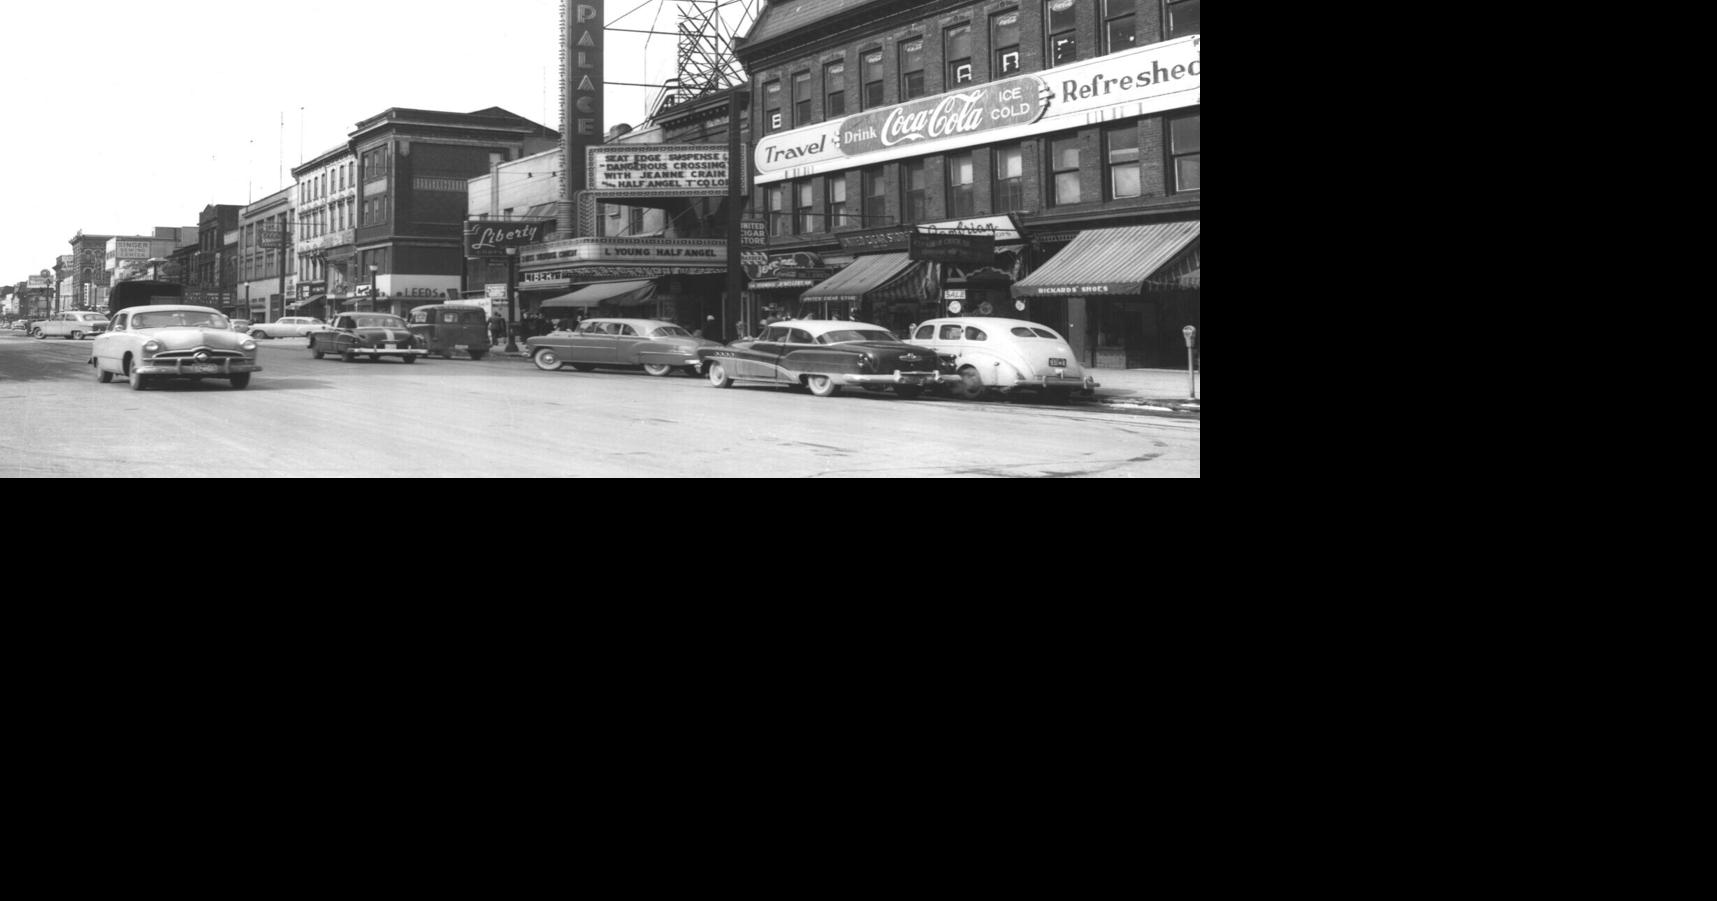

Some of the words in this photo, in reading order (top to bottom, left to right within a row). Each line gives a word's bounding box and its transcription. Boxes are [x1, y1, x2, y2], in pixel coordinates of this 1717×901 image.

[576, 4, 597, 136] PALACE
[991, 103, 1030, 120] COLD
[764, 134, 827, 163] Travel
[843, 126, 877, 144] Drink
[881, 90, 987, 146] Coca-Cola
[999, 87, 1022, 101] ICE
[605, 154, 630, 162] SEAT
[633, 154, 662, 162] EDGE
[668, 153, 720, 161] SUSPENSE
[604, 171, 631, 179] WITH
[640, 171, 684, 179] JEANNE
[690, 170, 726, 178] CRAIN
[618, 180, 644, 188] HALF
[647, 180, 682, 188] ANGEL
[471, 224, 537, 250] Liberty
[614, 248, 650, 257] YOUNG
[655, 248, 682, 256] HALF
[684, 248, 717, 257] ANGEL
[404, 287, 439, 298] LEEDS
